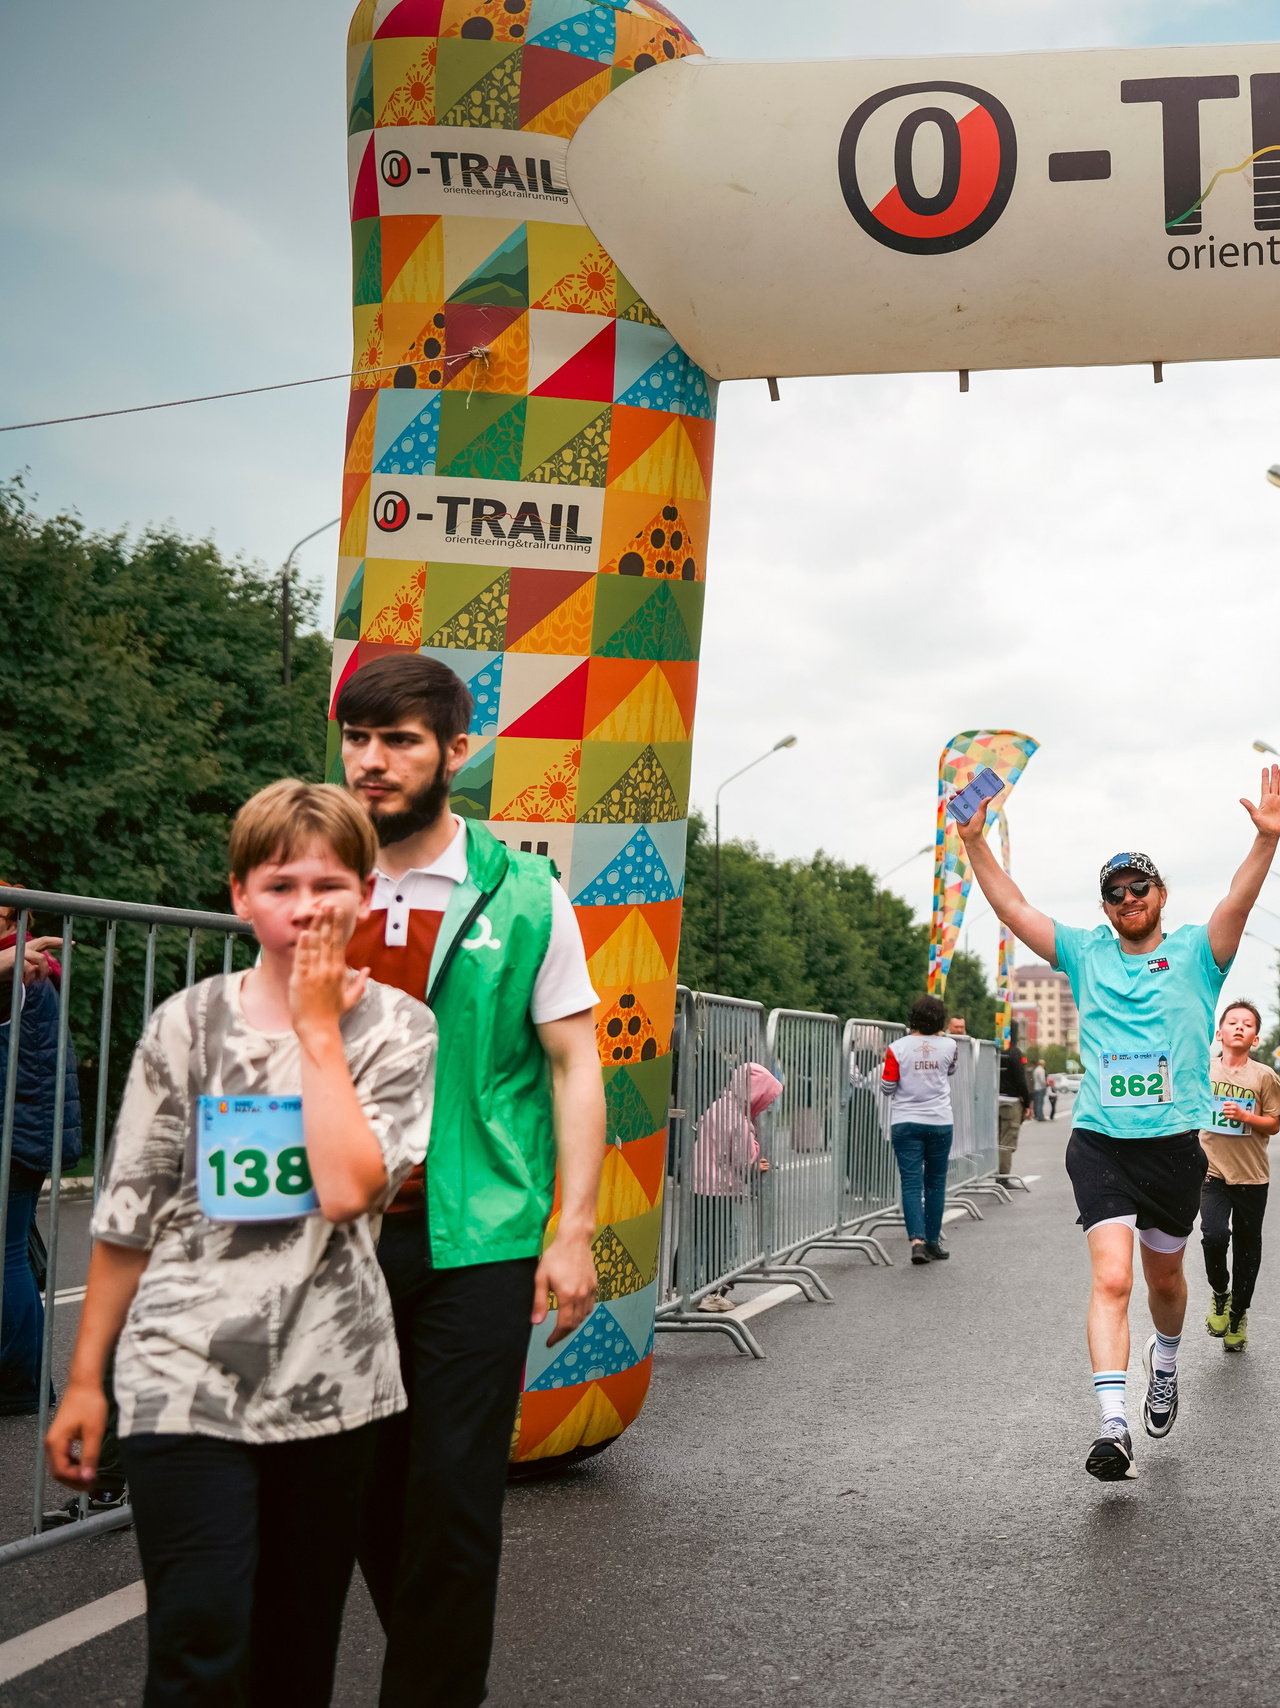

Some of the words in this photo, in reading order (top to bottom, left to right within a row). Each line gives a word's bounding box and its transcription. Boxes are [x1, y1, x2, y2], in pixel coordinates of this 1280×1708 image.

[443, 185, 569, 205] orienteering&trailrunning
[444, 535, 592, 554] orienteering&trailrunning
[914, 1060, 940, 1071] ЕЛЕНА
[1110, 1073, 1163, 1097] 862
[208, 1147, 313, 1197] 138
